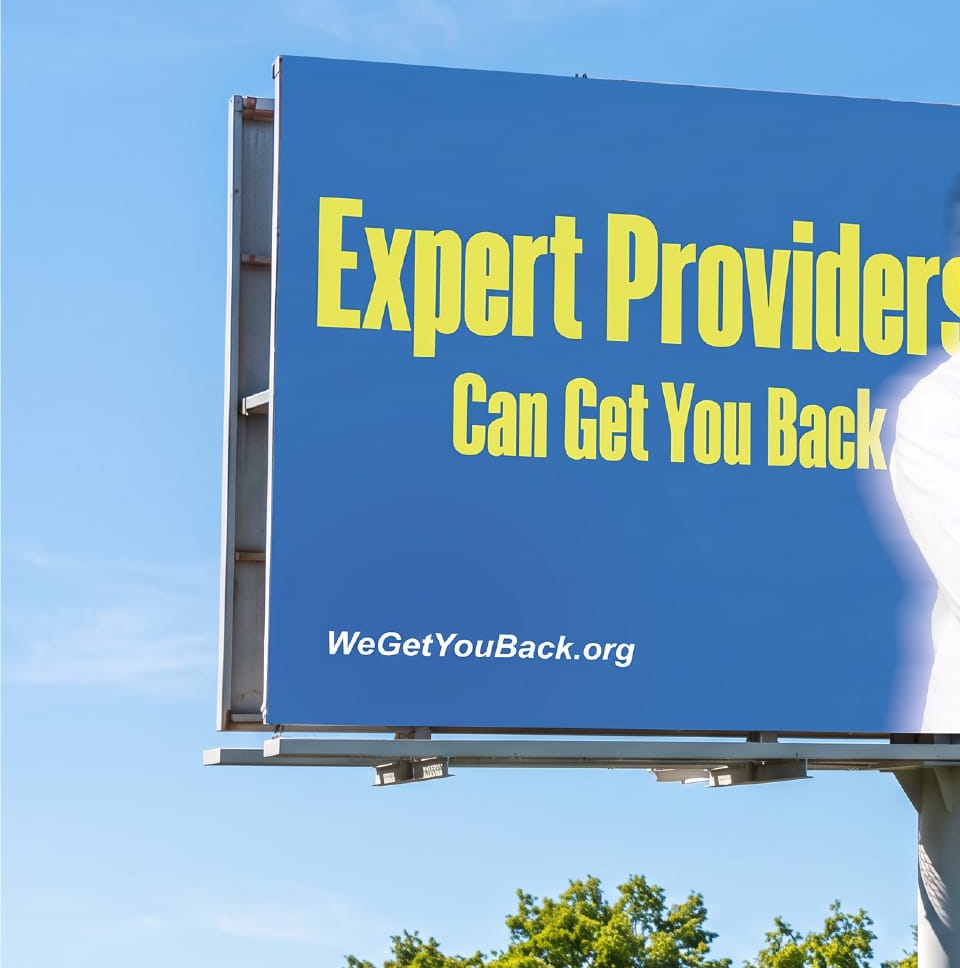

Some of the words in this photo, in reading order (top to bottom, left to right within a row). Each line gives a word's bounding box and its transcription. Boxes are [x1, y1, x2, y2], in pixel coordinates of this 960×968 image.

[317, 197, 582, 357] Expert
[453, 373, 547, 458] Can
[564, 378, 648, 462] Get
[661, 382, 751, 466] You
[767, 387, 888, 471] Back
[327, 630, 635, 668] WeGetYouBack.org
